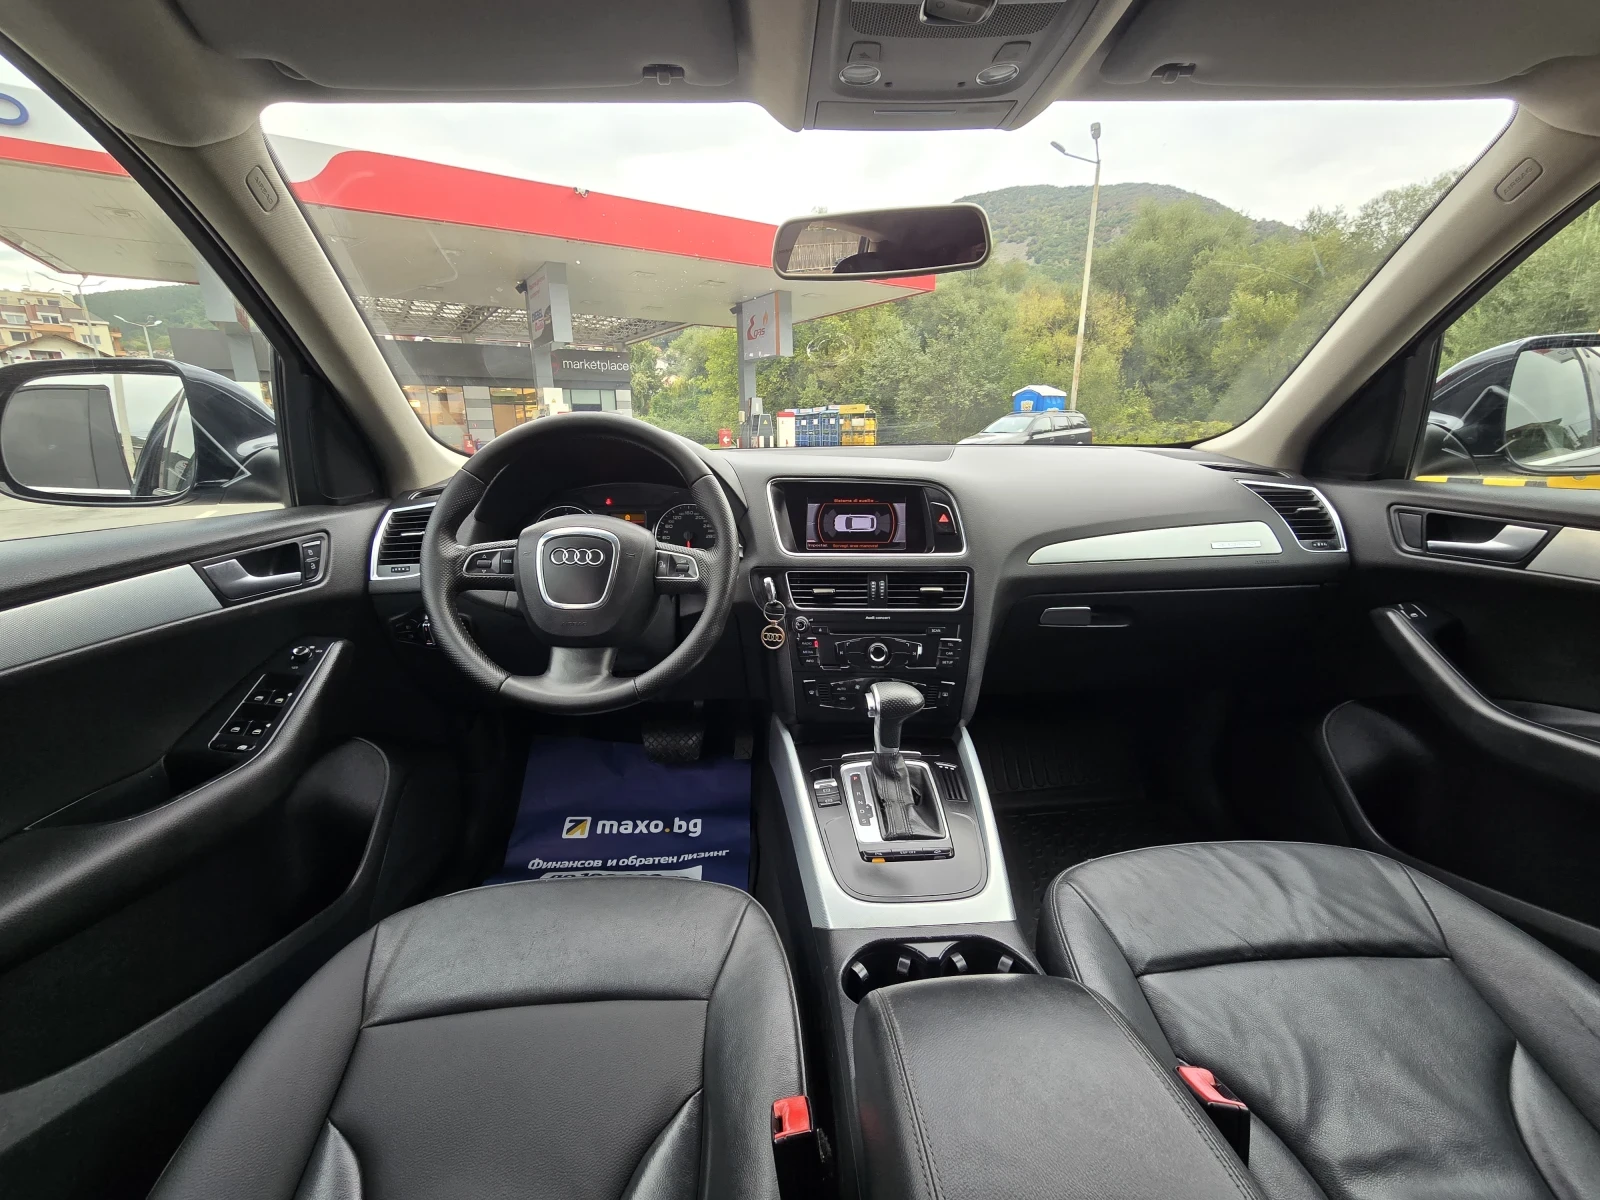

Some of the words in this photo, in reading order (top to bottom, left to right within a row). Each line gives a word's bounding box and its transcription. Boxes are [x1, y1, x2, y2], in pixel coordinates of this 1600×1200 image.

[254, 176, 274, 205] AIRBAG
[1503, 166, 1533, 195] AIRBAG
[562, 359, 629, 372] marketplace
[596, 816, 703, 838] maxo.bg
[527, 857, 602, 871] Финансов
[606, 858, 617, 867] и
[619, 854, 678, 868] обратен
[678, 849, 730, 863] лизинг
